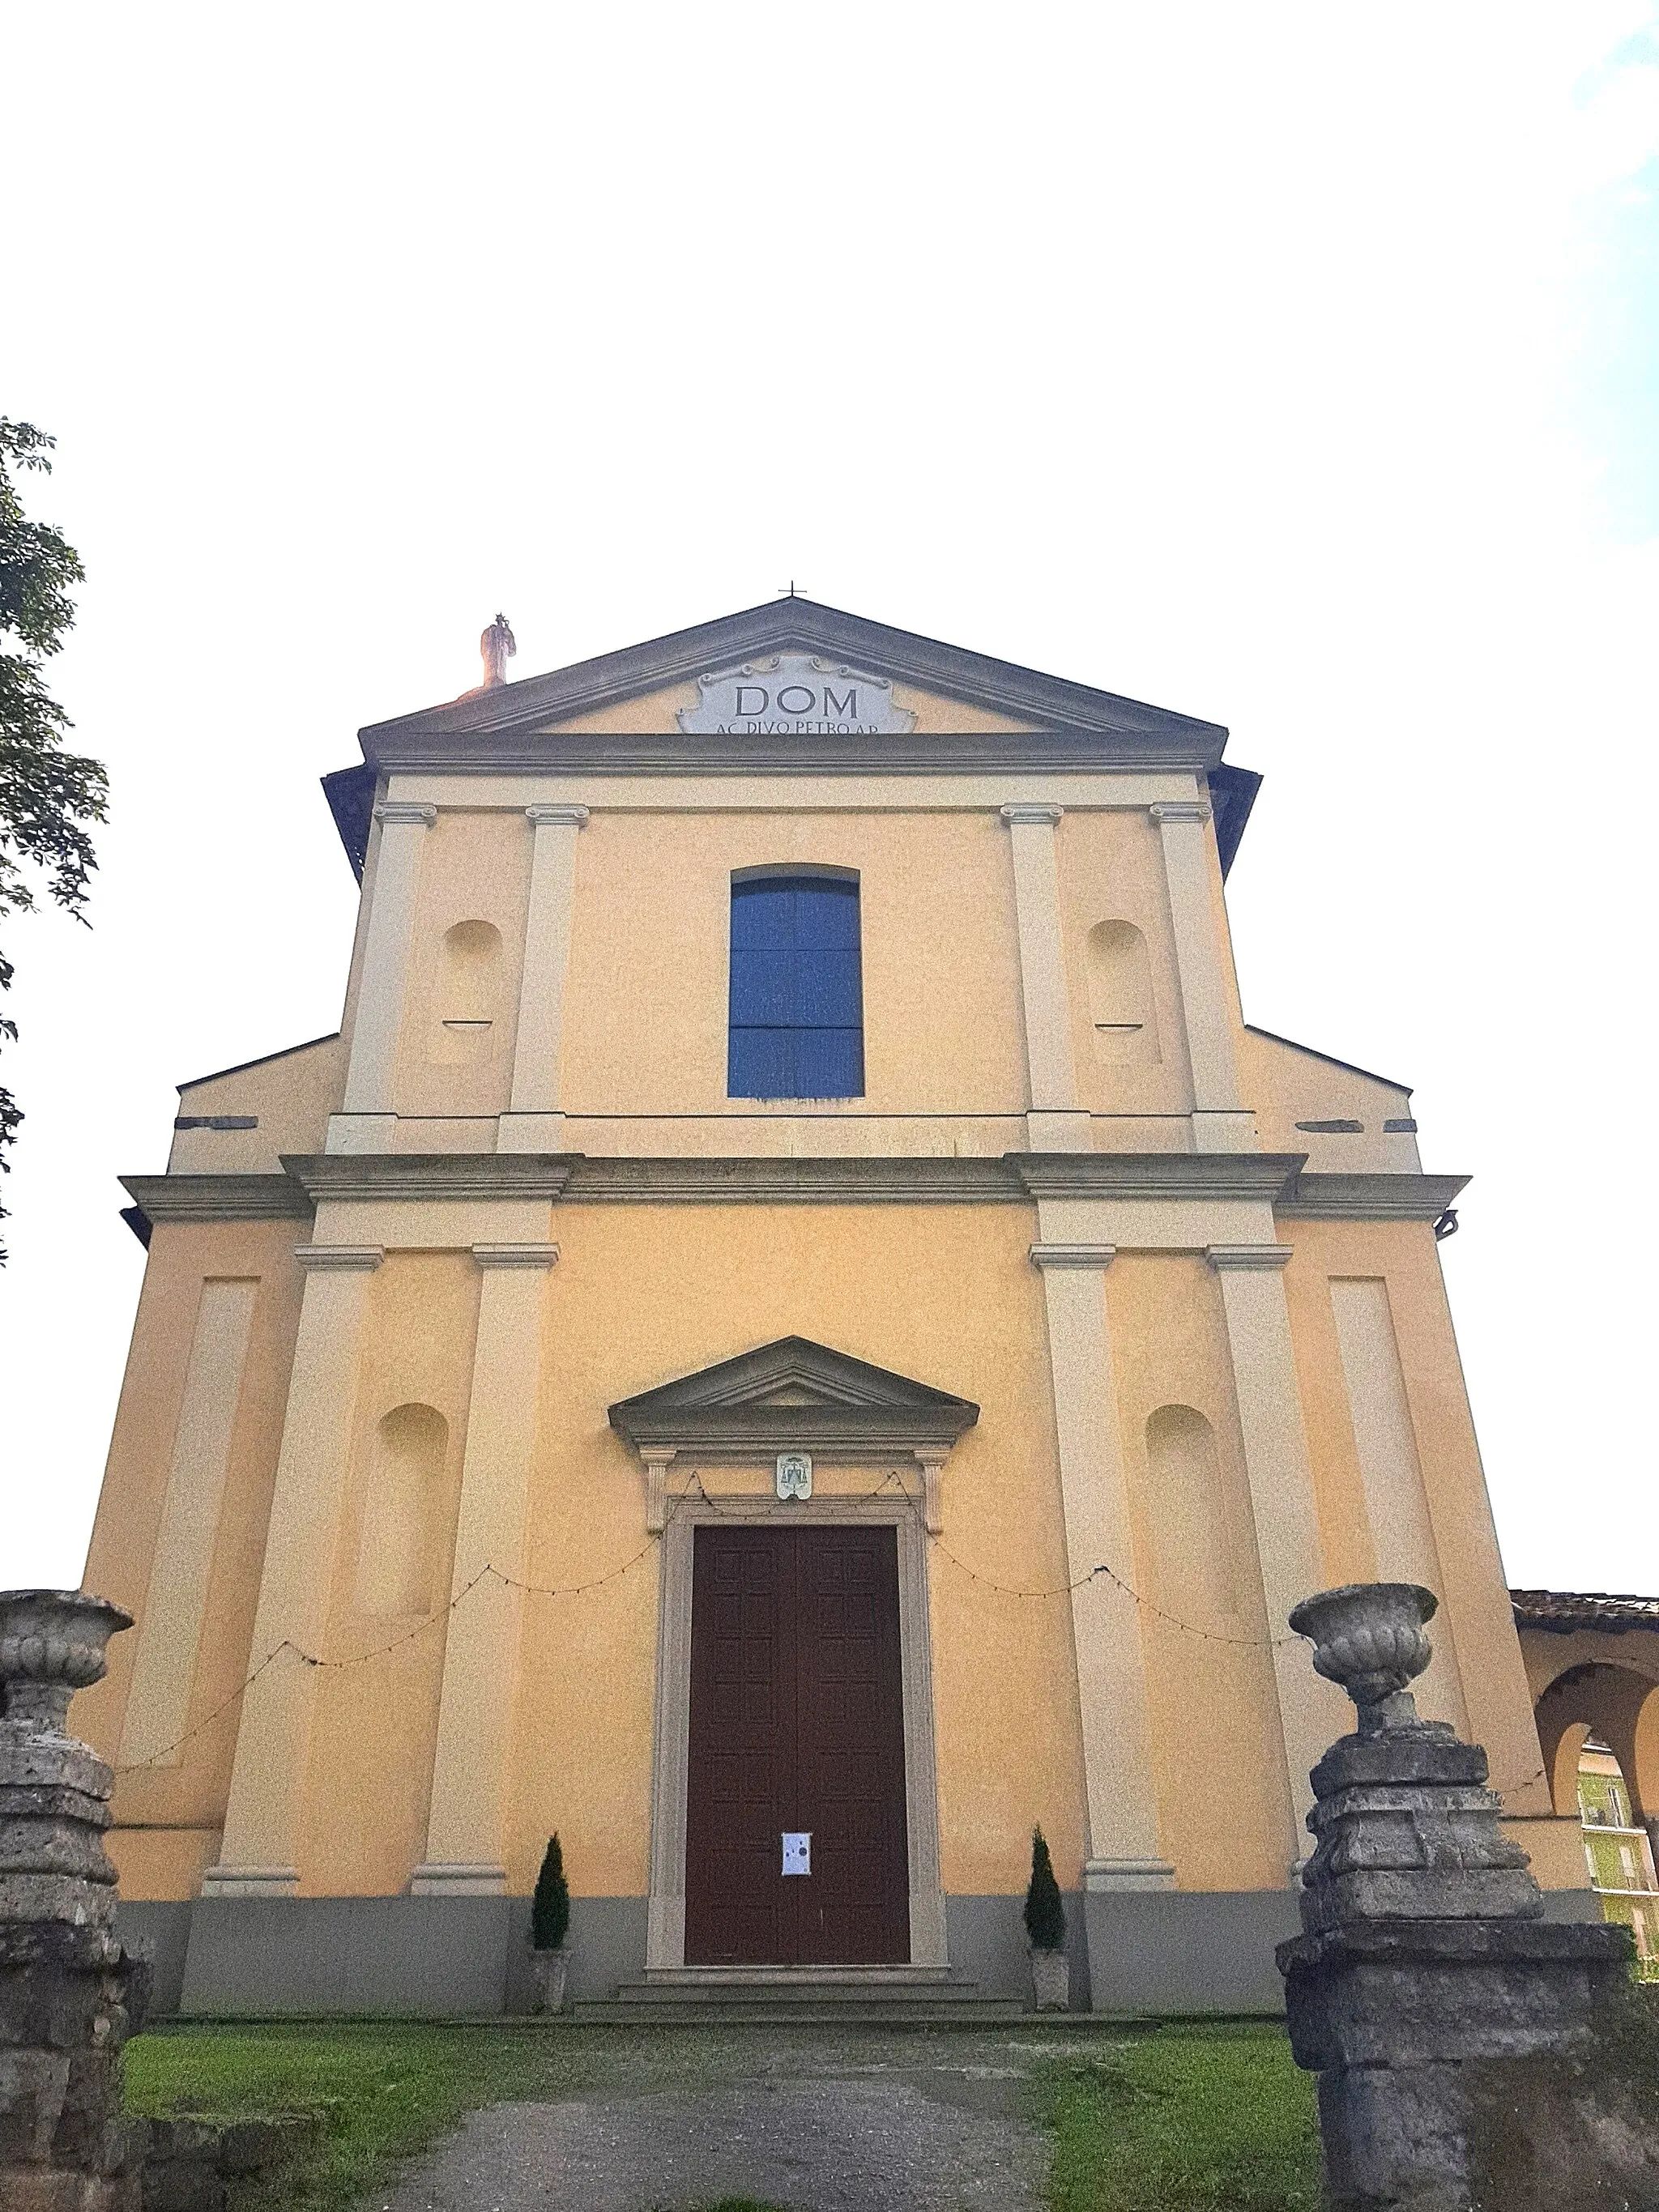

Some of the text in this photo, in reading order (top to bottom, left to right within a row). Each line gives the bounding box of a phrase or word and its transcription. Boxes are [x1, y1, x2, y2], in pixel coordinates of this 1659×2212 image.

[735, 685, 859, 719] DOM
[748, 721, 790, 735] DIVO
[795, 721, 850, 735] PETRO
